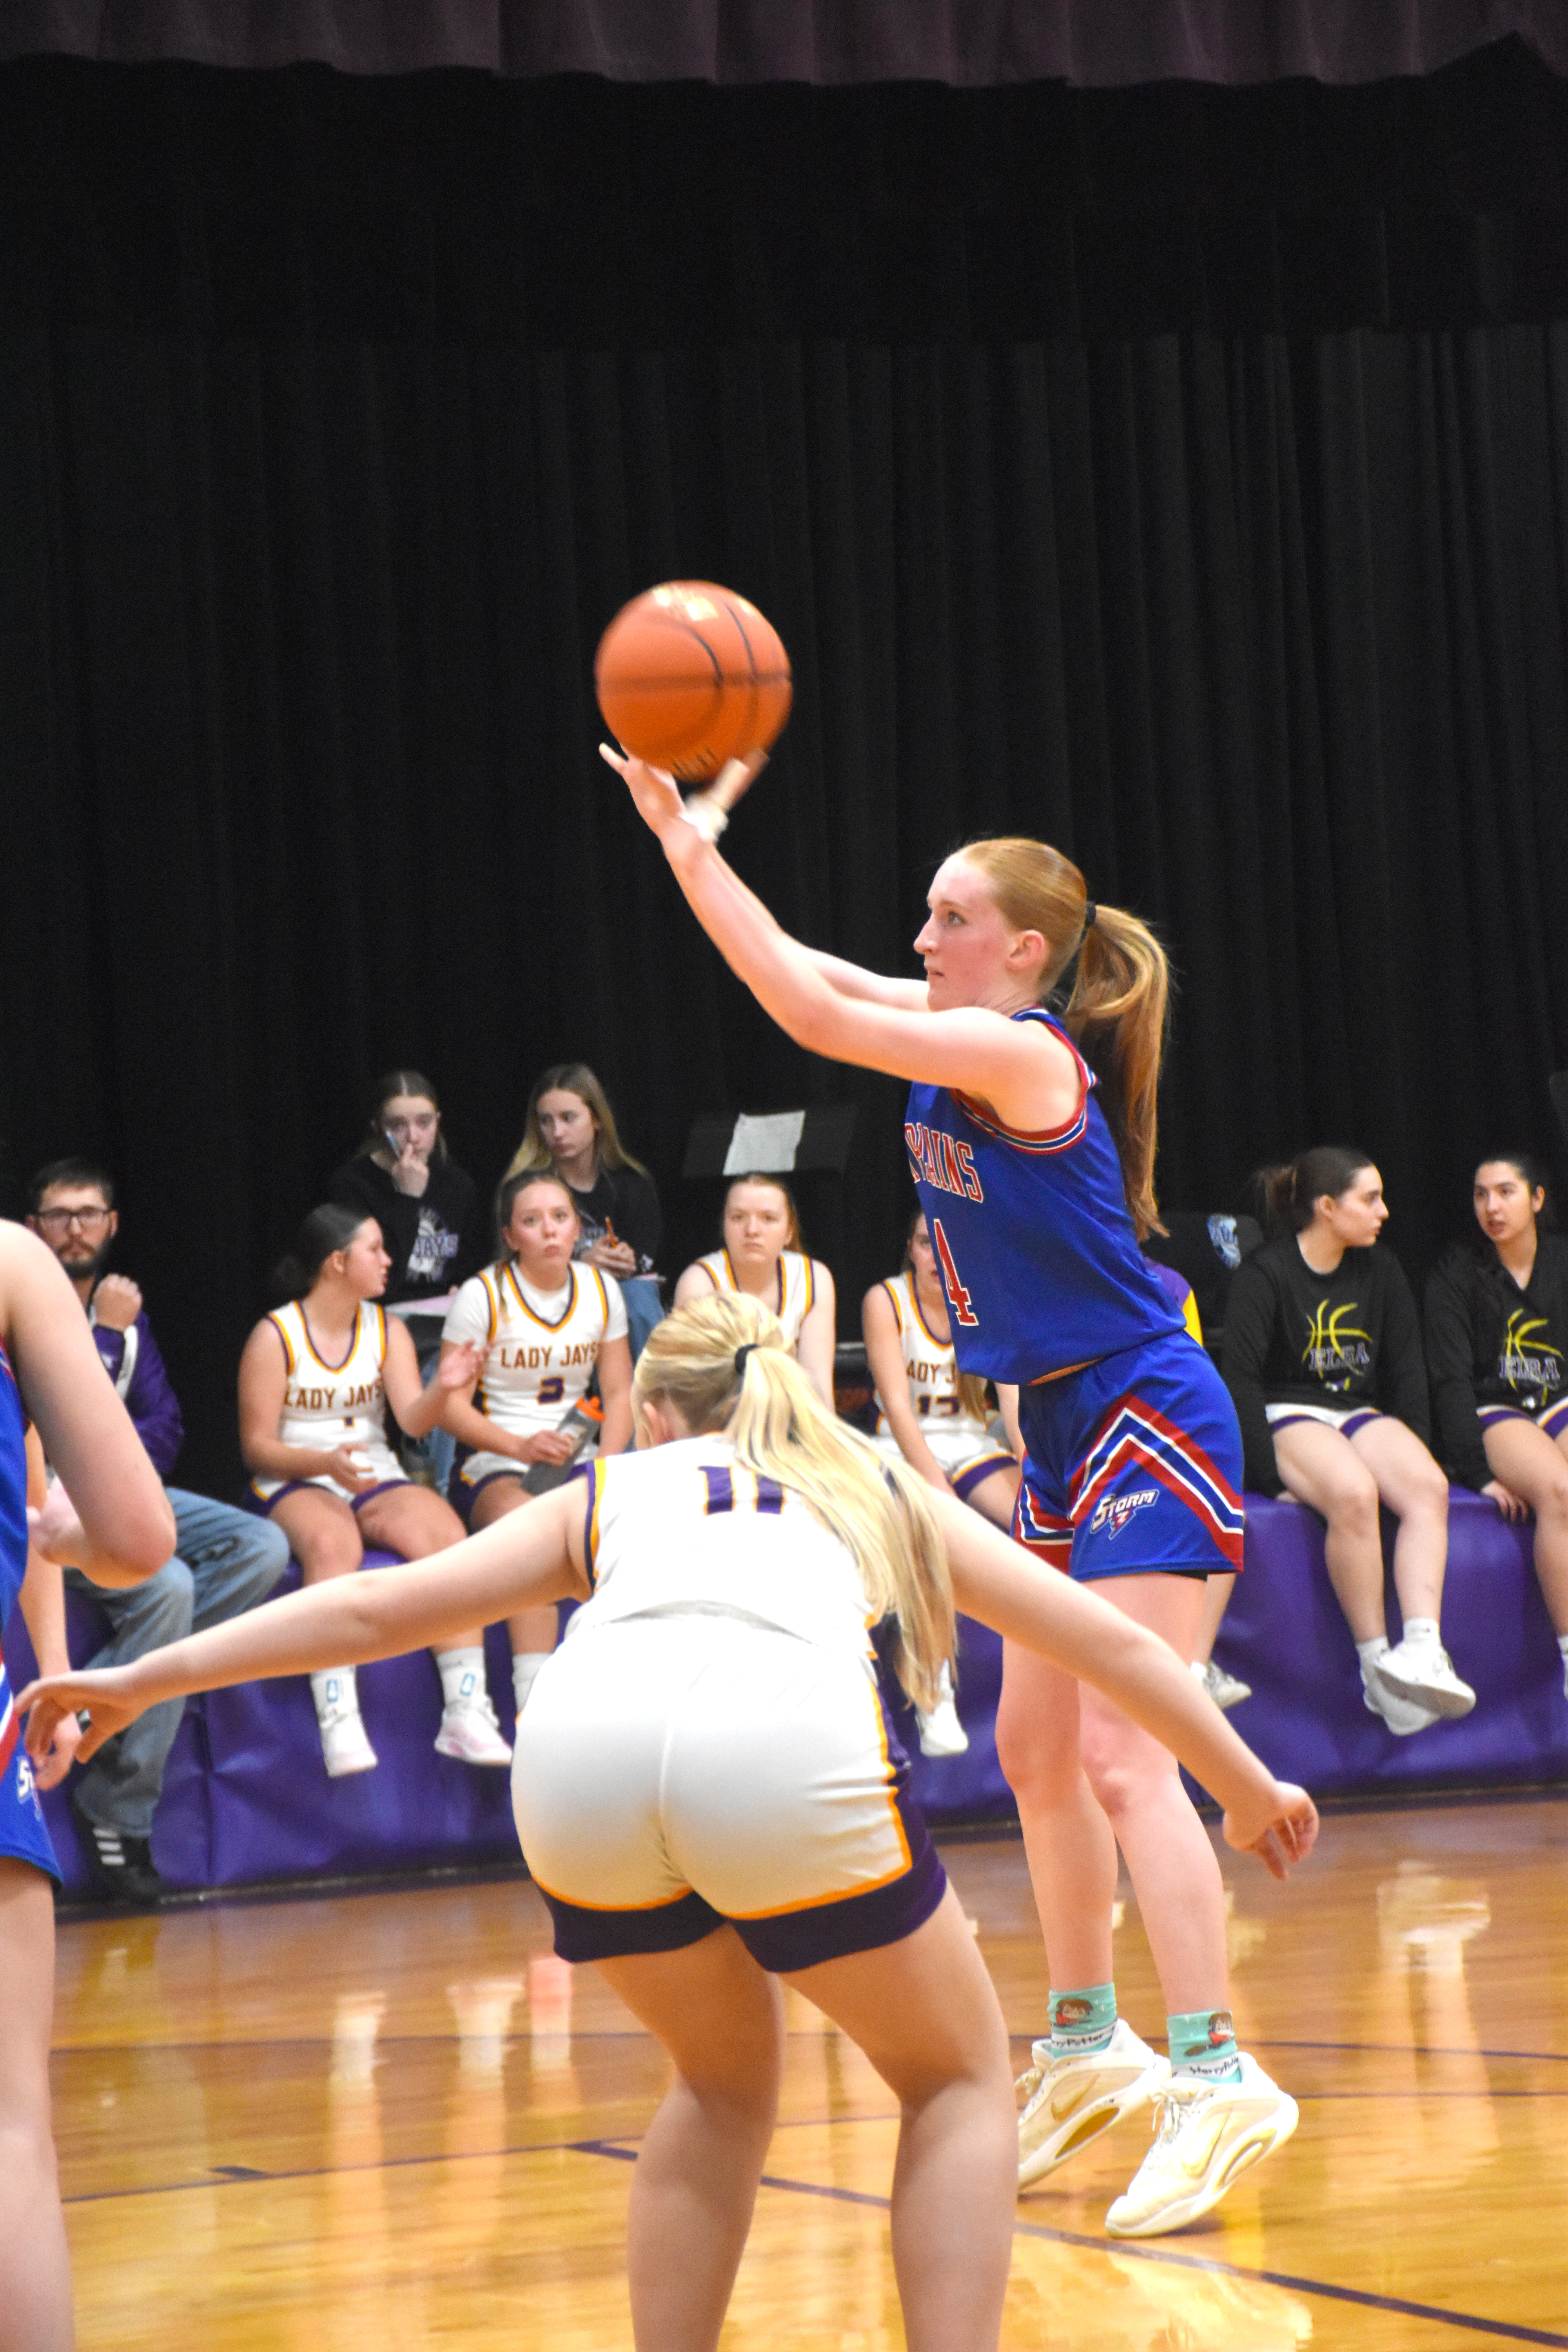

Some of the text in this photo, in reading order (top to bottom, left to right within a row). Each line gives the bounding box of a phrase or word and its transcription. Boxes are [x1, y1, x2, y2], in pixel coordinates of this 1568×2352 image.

[933, 1218, 979, 1327] 4
[500, 1345, 553, 1369] LADY
[906, 1358, 941, 1384] ADY
[283, 1382, 337, 1410] LADY
[1091, 1492, 1156, 1531] STORM
